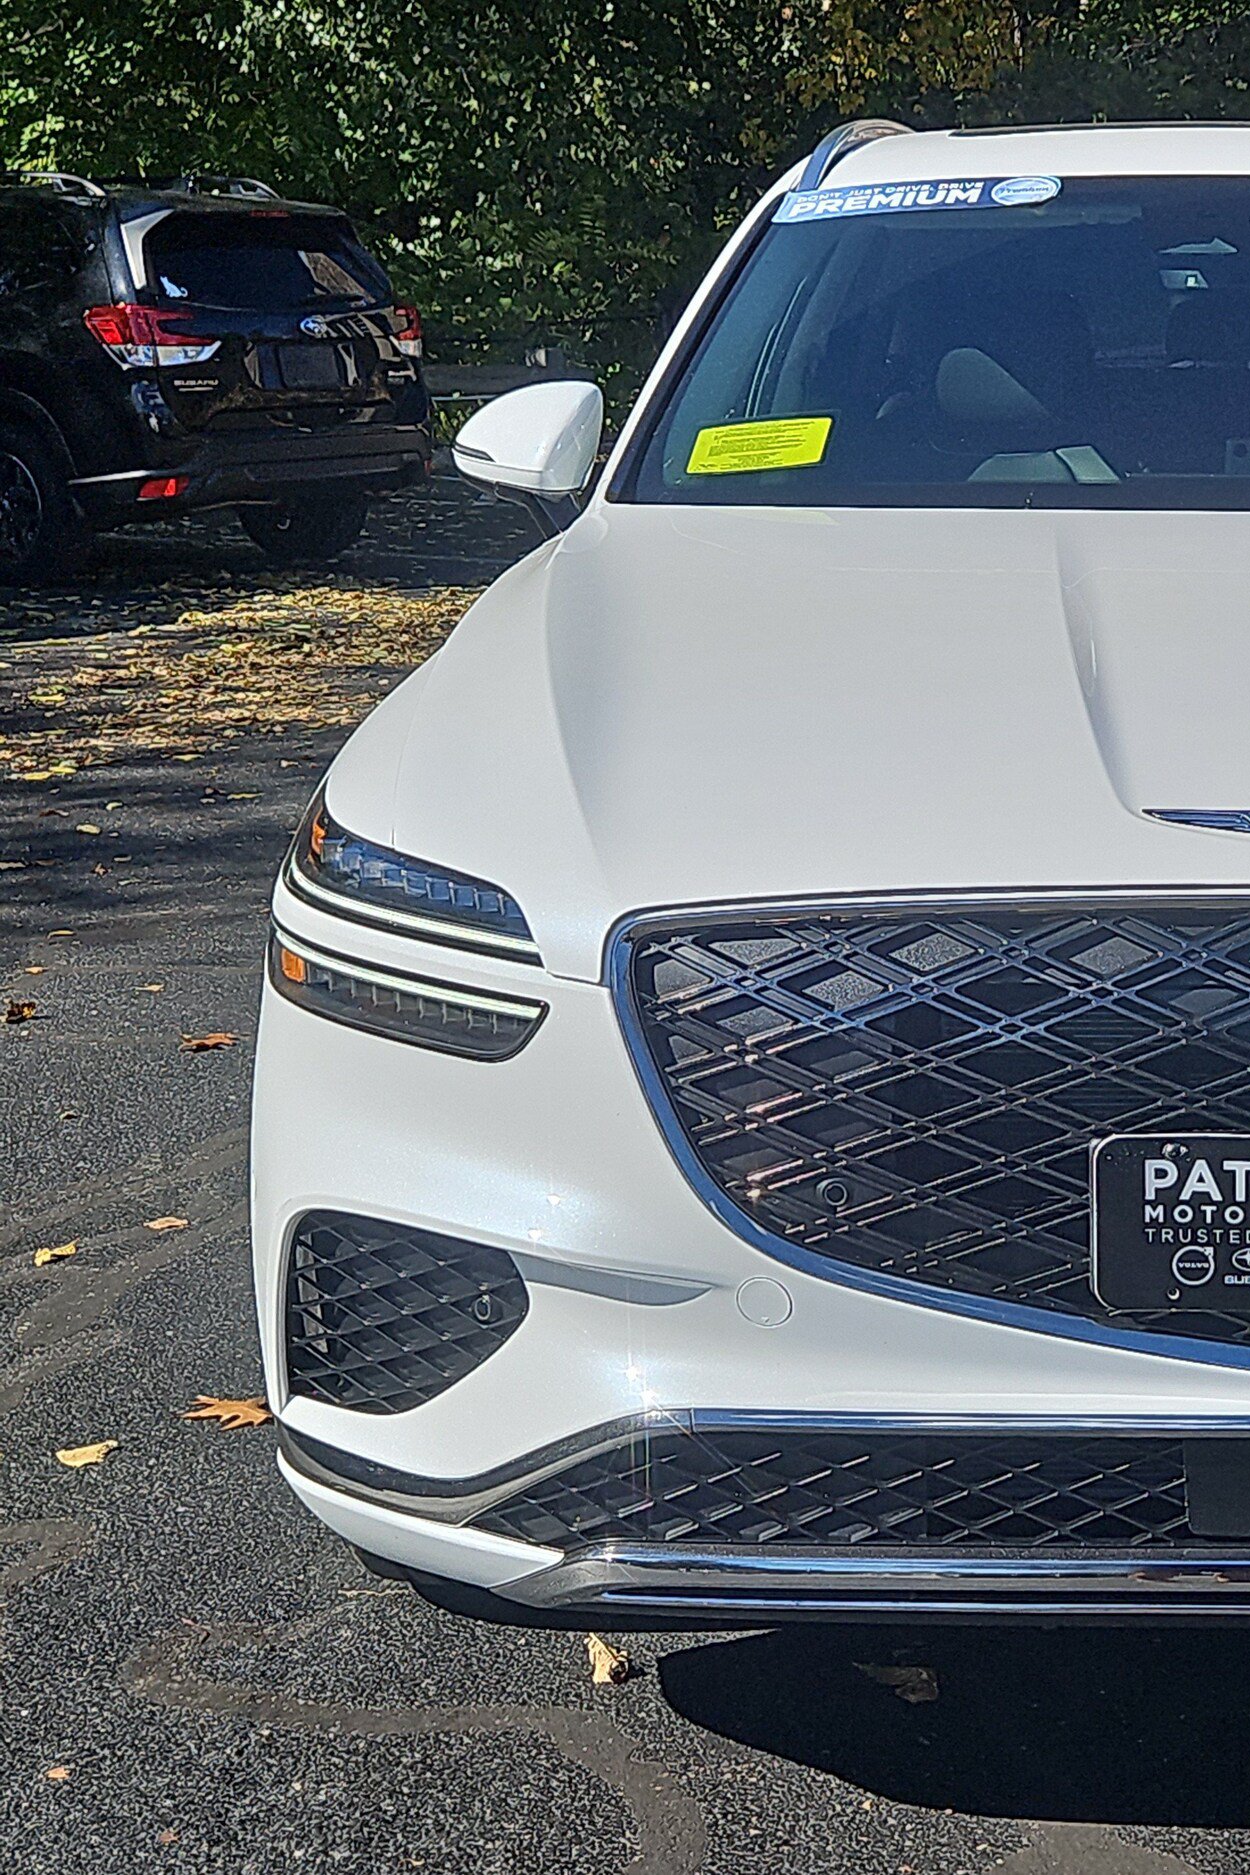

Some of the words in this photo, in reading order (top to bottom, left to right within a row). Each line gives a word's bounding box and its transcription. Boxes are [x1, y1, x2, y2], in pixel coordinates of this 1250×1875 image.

[788, 187, 982, 218] PREMIUM
[797, 192, 843, 203] DON'T
[846, 187, 883, 198] JUST
[937, 181, 985, 191] DRIVE
